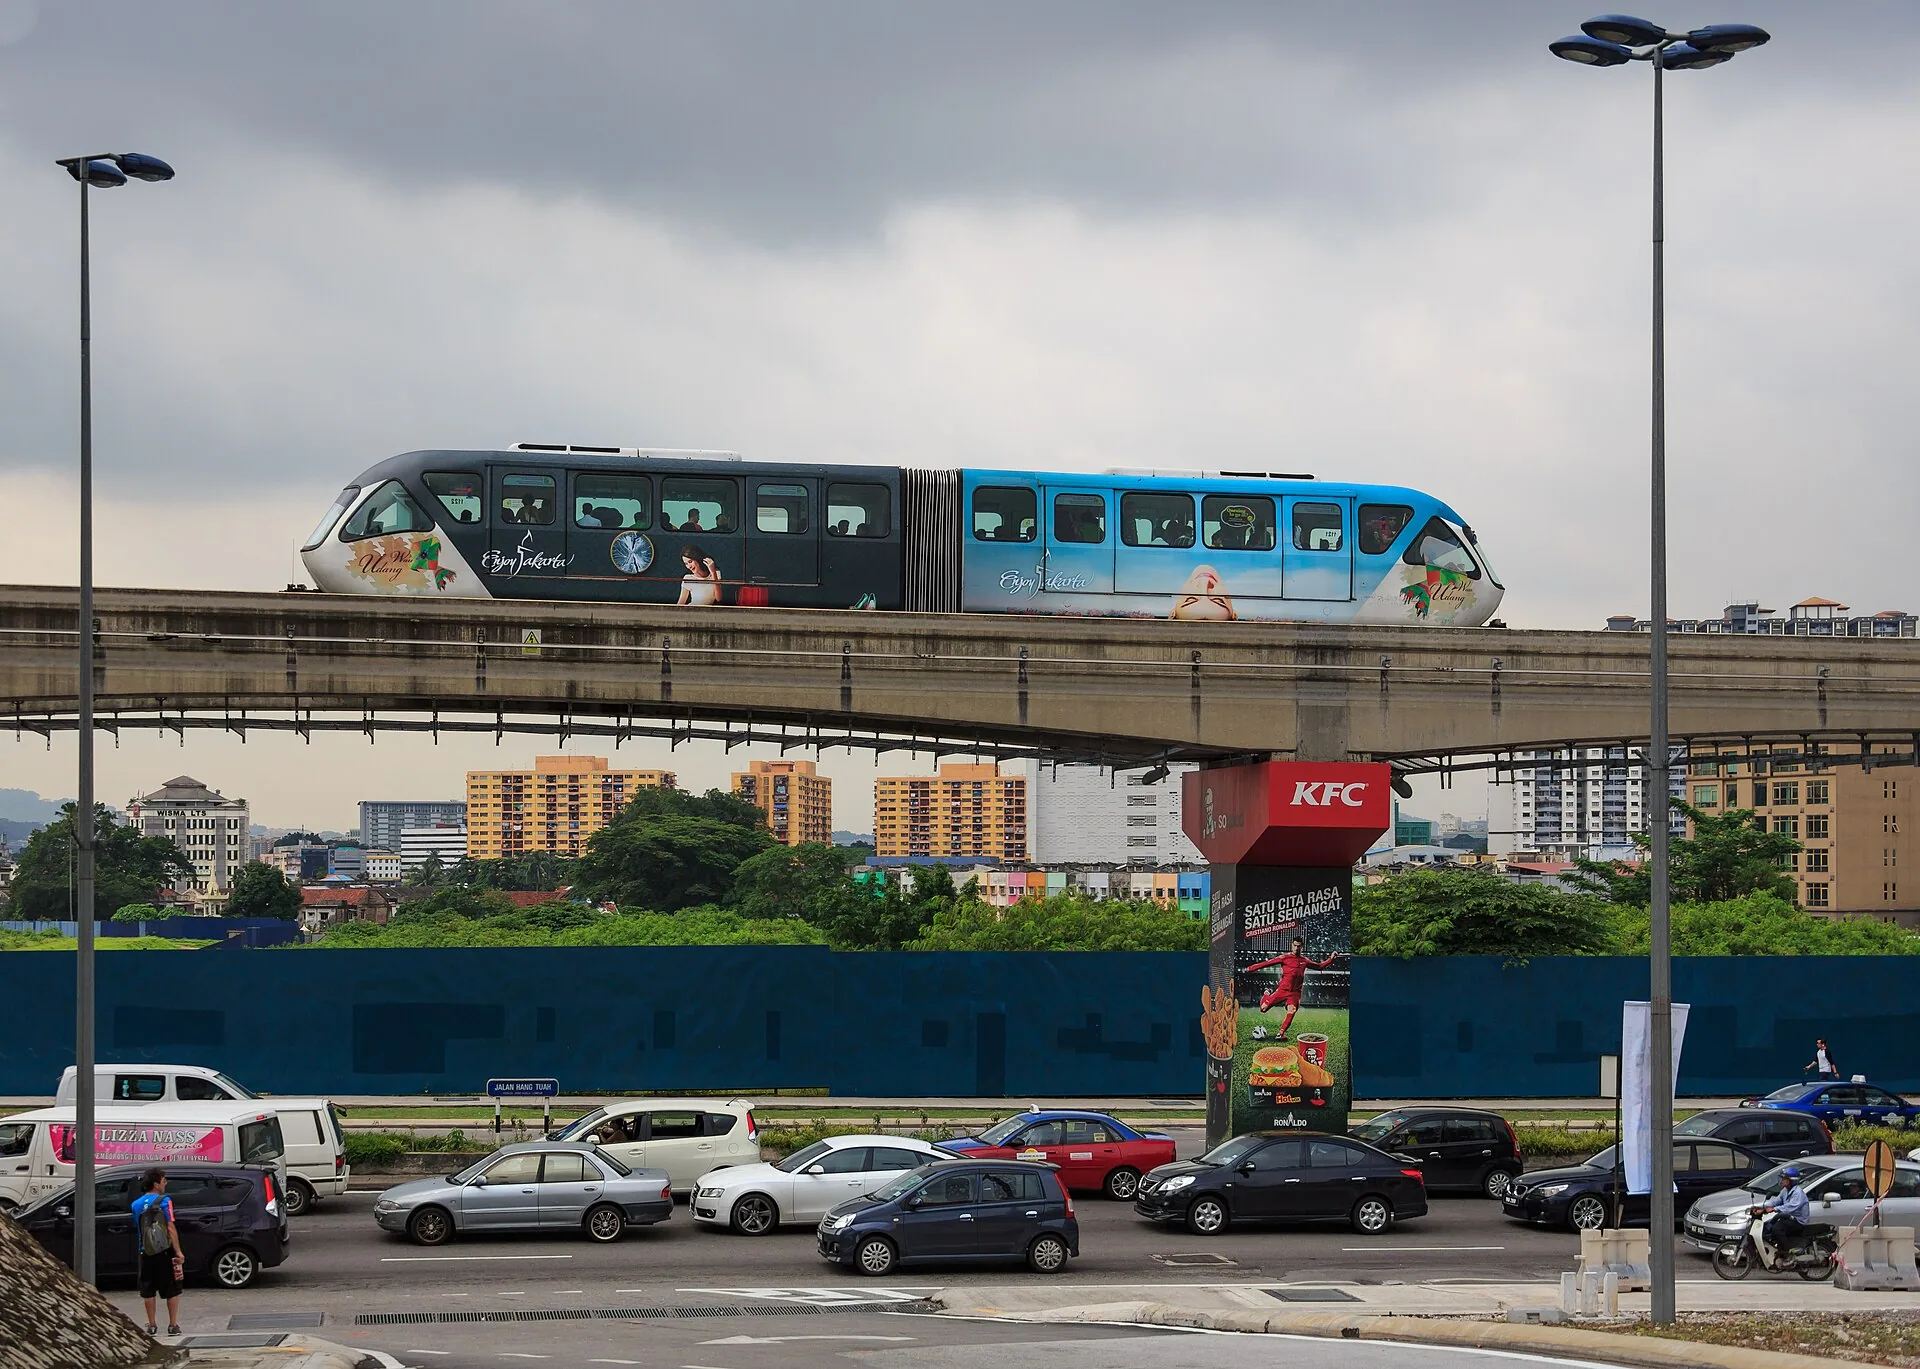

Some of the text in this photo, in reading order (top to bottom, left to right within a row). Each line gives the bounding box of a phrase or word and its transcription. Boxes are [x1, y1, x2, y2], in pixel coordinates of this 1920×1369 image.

[358, 554, 403, 582] Udang
[481, 541, 576, 579] Enjoy Jakarta
[999, 564, 1095, 600] Enjoy Jakarta
[1429, 583, 1466, 609] Udang
[1289, 781, 1366, 807] KFC
[1244, 886, 1340, 918] SATU CITA RASA
[1244, 897, 1342, 930] SATU SEMANGAT
[1245, 921, 1296, 938] CRISTIANO RONALDO
[494, 1083, 552, 1091] JALAN HANG TUAH
[1273, 1112, 1308, 1126] RONALDO
[101, 1129, 196, 1143] LIZZA NASS
